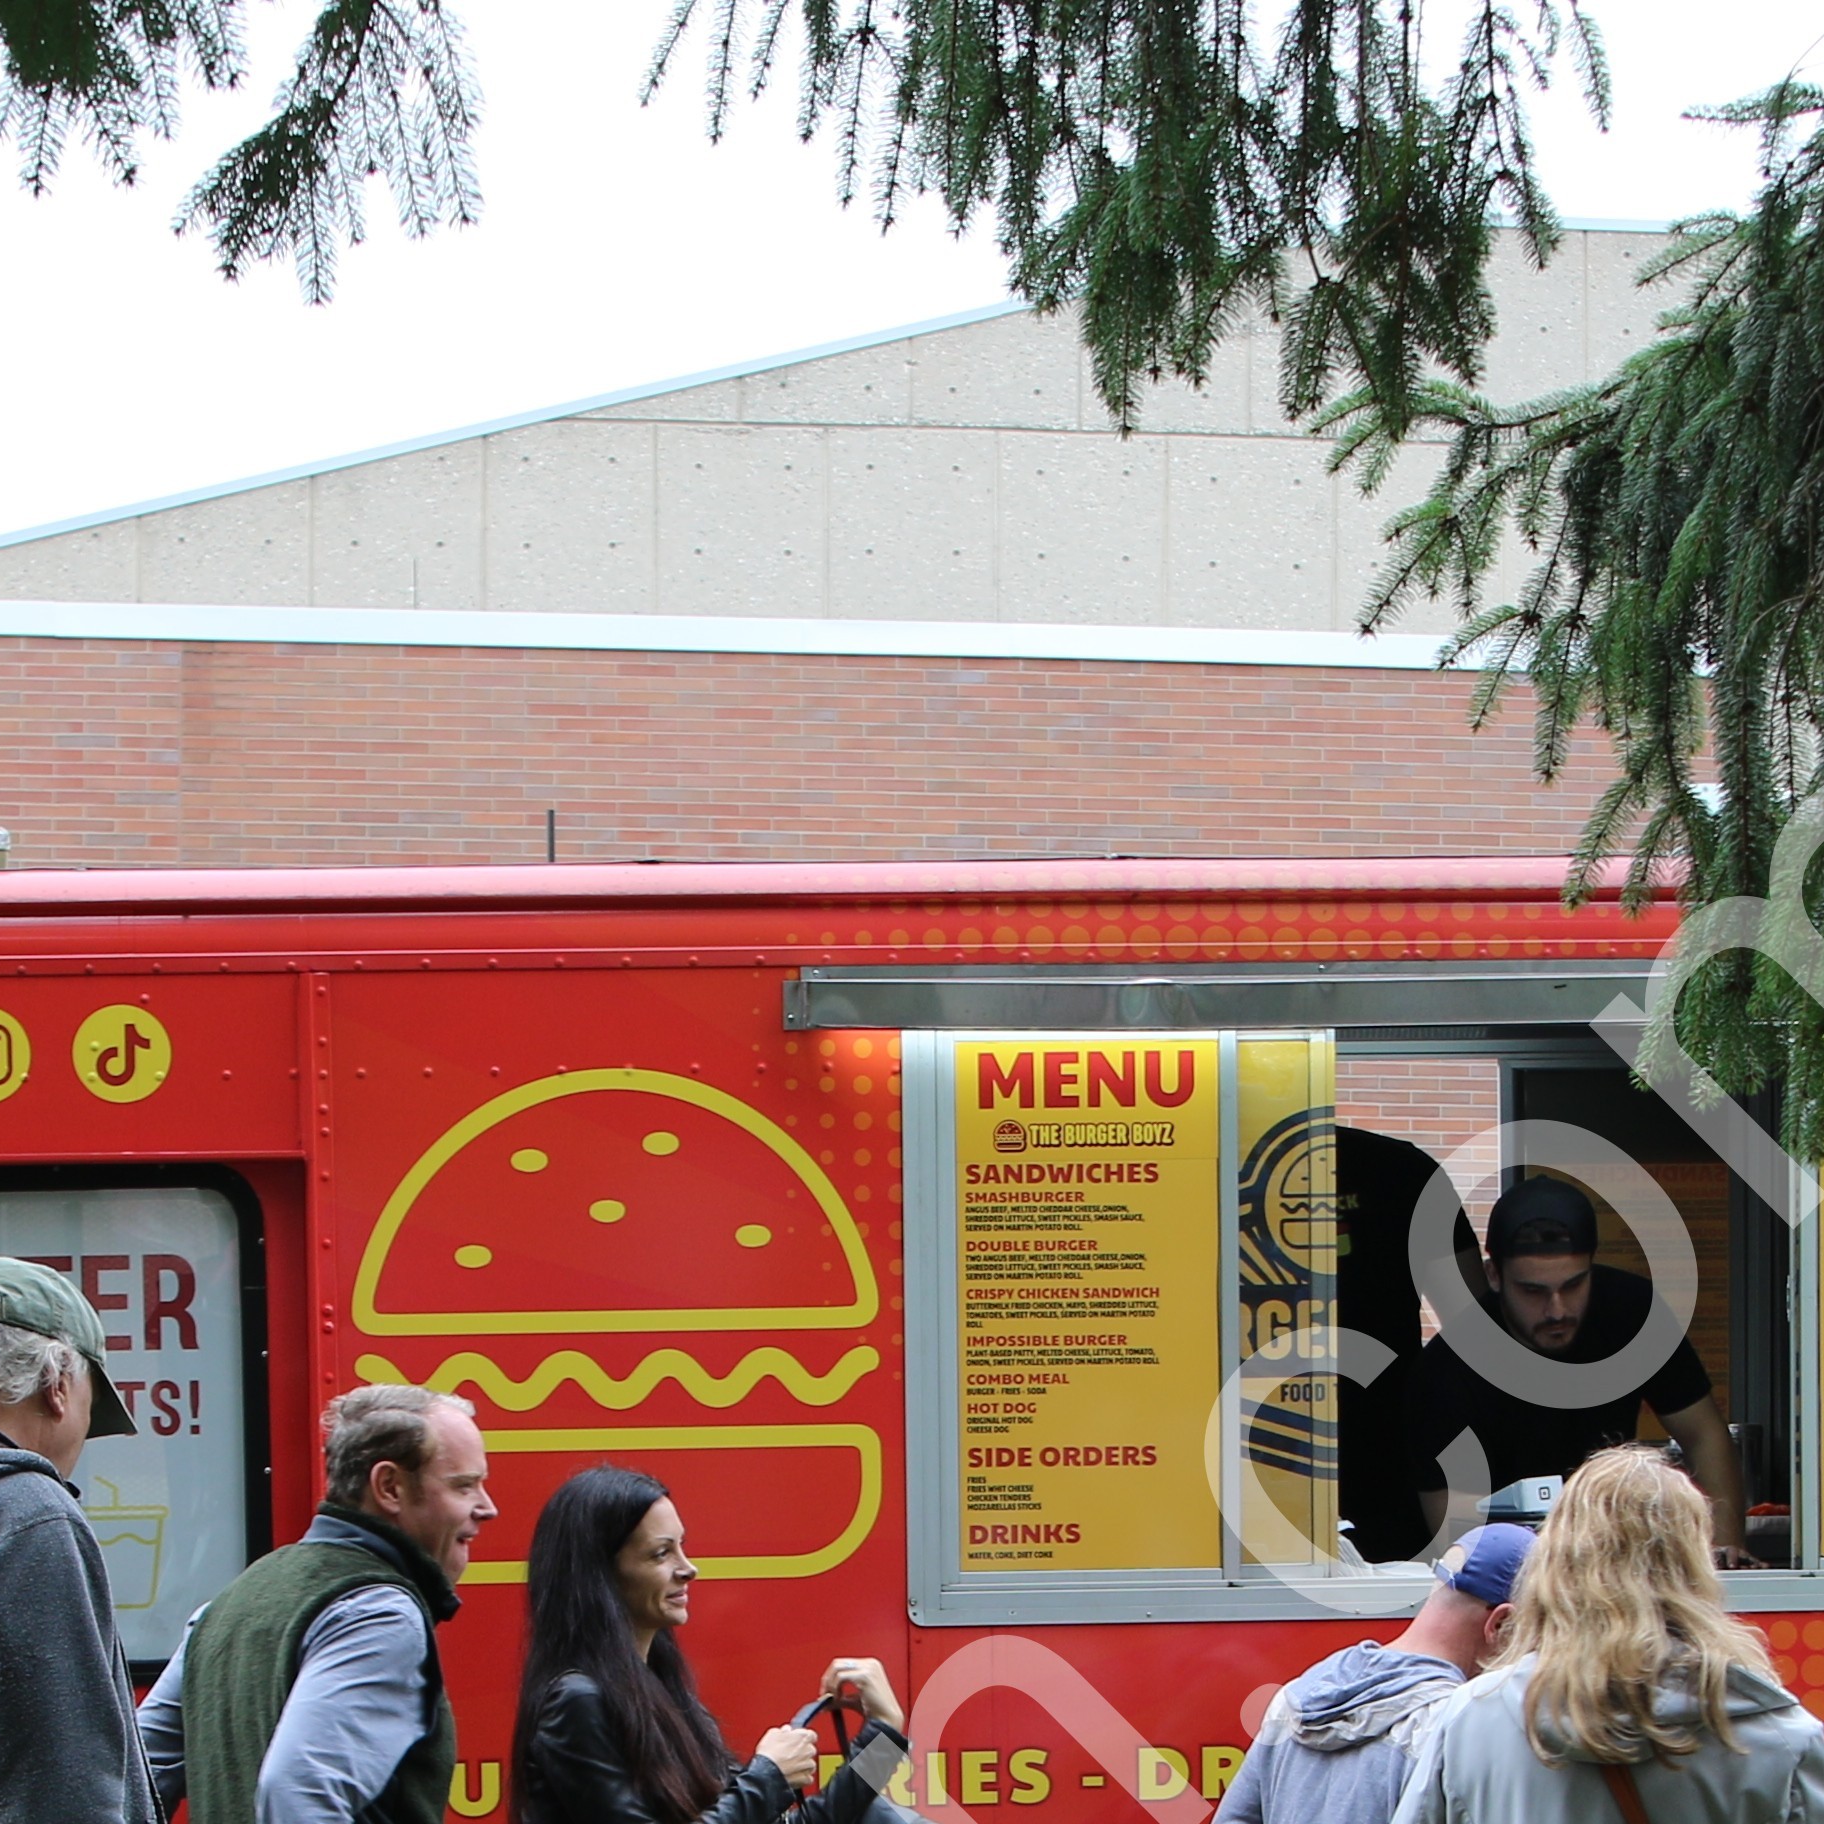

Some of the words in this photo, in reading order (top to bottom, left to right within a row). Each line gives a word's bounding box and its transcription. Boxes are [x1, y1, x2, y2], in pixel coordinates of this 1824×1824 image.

[977, 1050, 1195, 1110] MENU
[1029, 1123, 1060, 1147] THE
[1064, 1123, 1127, 1147] BURGER
[1132, 1122, 1174, 1147] BOYZ
[966, 1164, 1158, 1184] SANDWICHES
[966, 1192, 1084, 1203] SMASHBURGER
[966, 1241, 1029, 1251] DOUBLE
[1034, 1240, 1097, 1251] BURGER
[966, 1289, 1014, 1299] CRISPY
[1017, 1288, 1079, 1299] CHICKEN
[1083, 1288, 1159, 1298] SANDWICH
[967, 1336, 1059, 1346] IMPOSSIBLE
[1064, 1335, 1127, 1346] BURGER
[967, 1374, 1024, 1385] COMBO
[1029, 1374, 1069, 1384] MEAL
[1280, 1383, 1326, 1403] FOOD
[968, 1403, 999, 1413] HOT
[1003, 1403, 1036, 1413] DOG
[968, 1448, 1032, 1468] SIDE
[1039, 1446, 1157, 1466] ORDERS
[970, 1524, 1080, 1544] DRINKS
